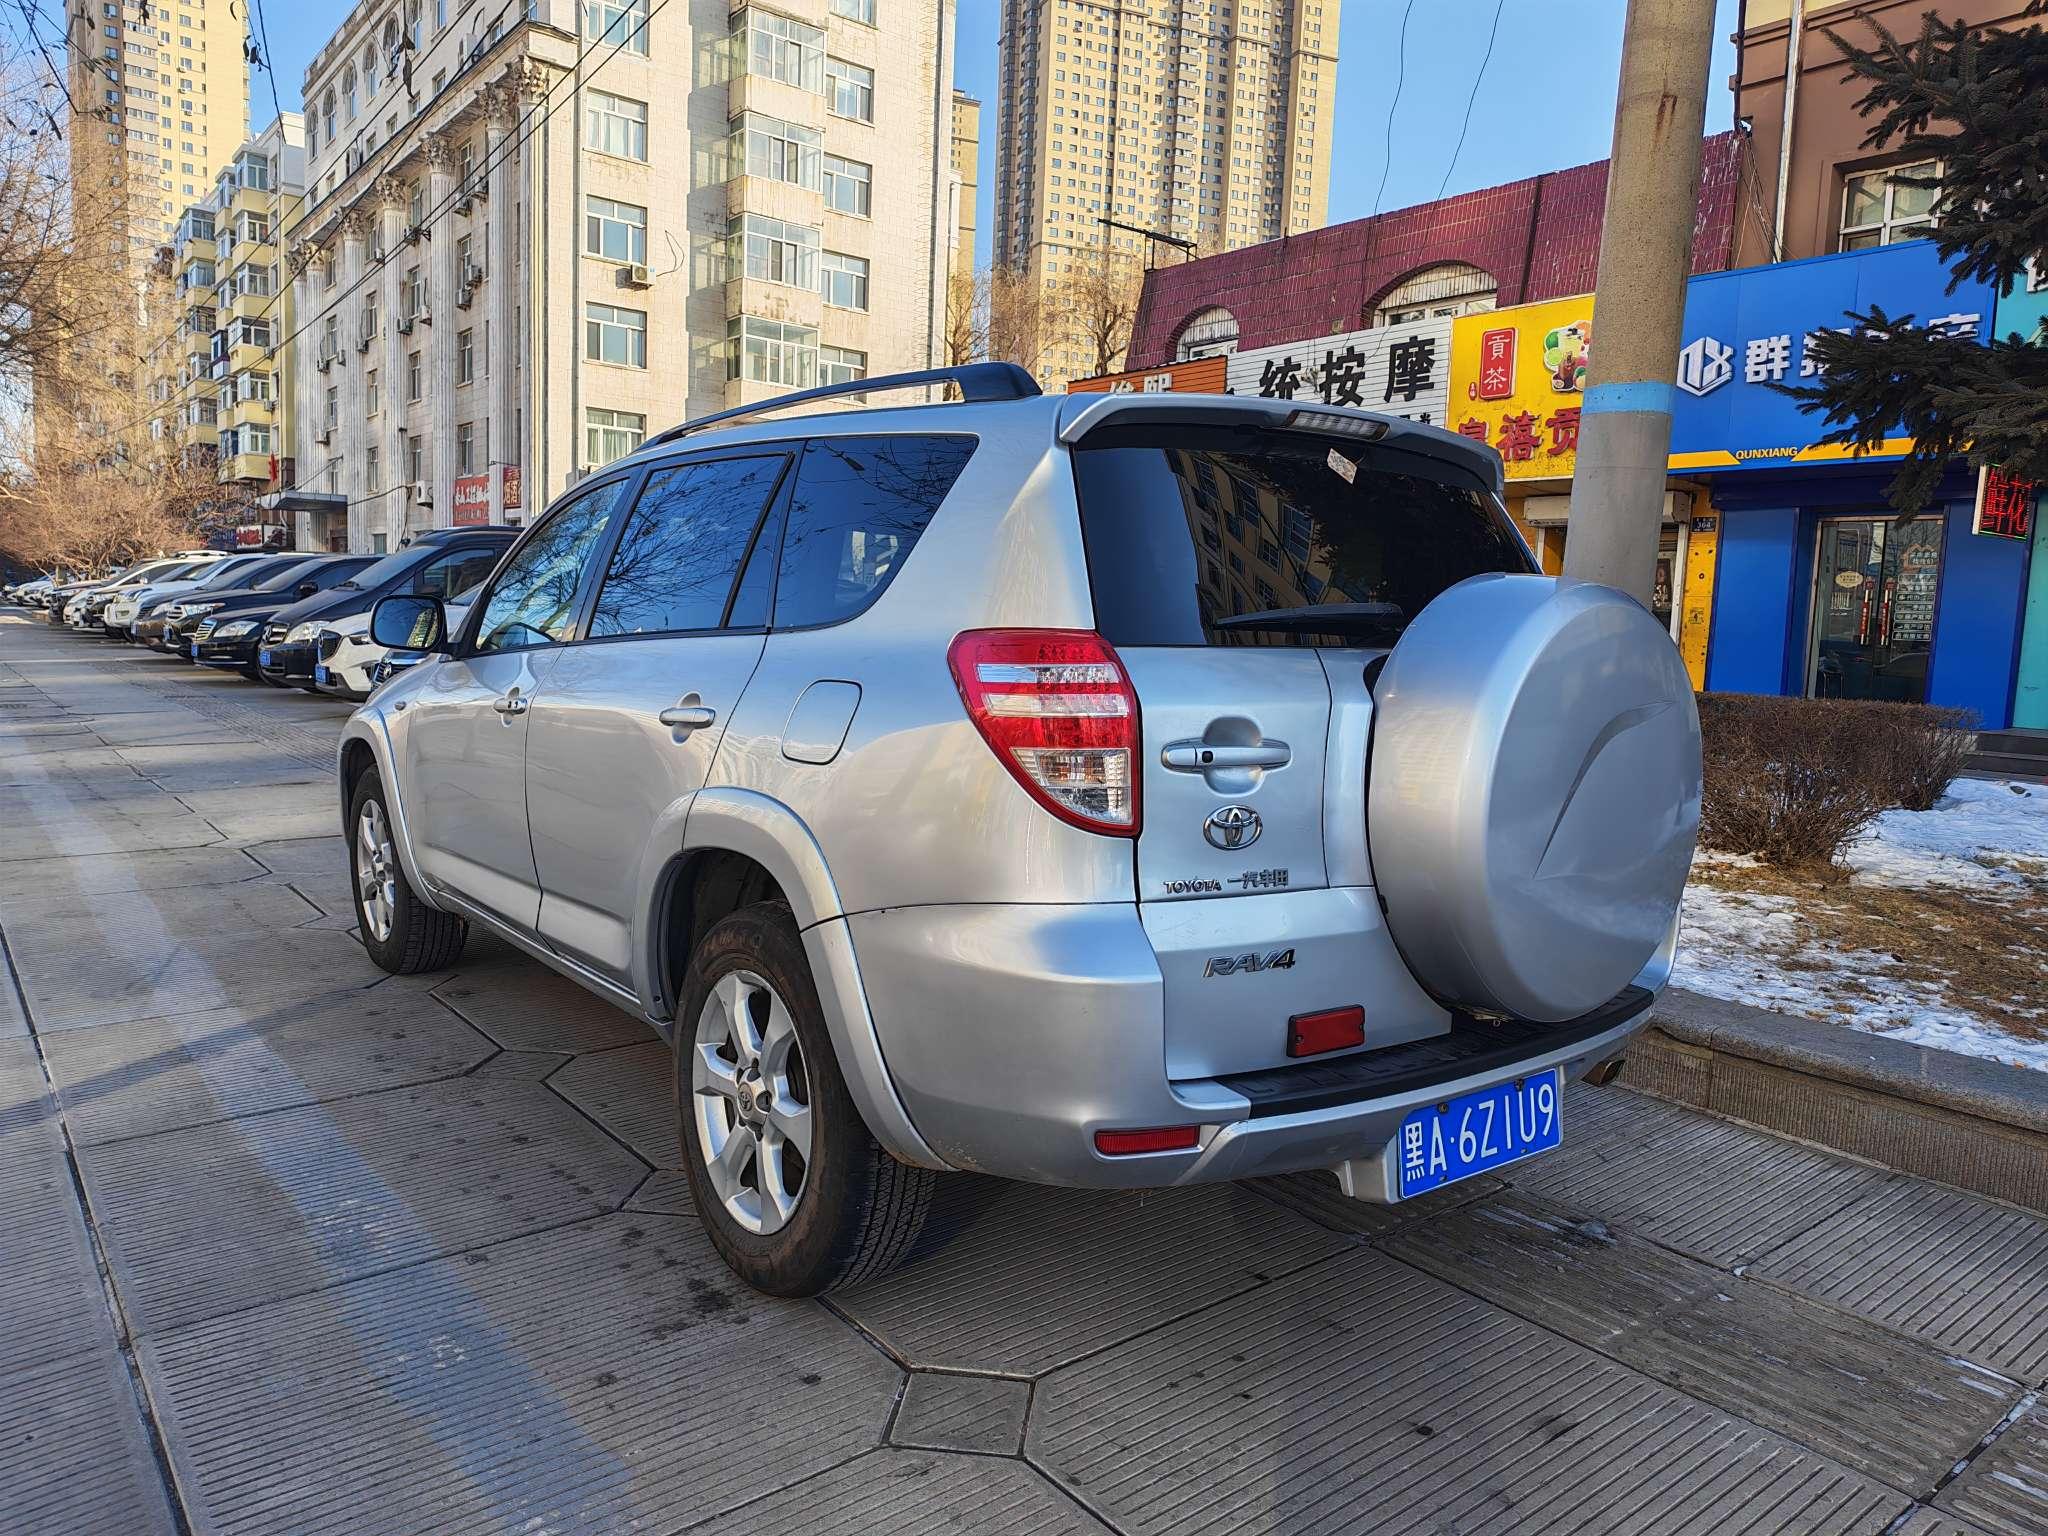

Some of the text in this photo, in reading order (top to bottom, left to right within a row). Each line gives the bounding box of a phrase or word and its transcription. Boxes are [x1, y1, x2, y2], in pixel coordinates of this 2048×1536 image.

[1226, 335, 1436, 407] 统按摩
[1484, 334, 1510, 391] 貢茶
[1735, 446, 1798, 460] QUNXIANG
[1163, 868, 1289, 895] TOYOTA 一汽丰田
[1203, 946, 1296, 978] RAV4
